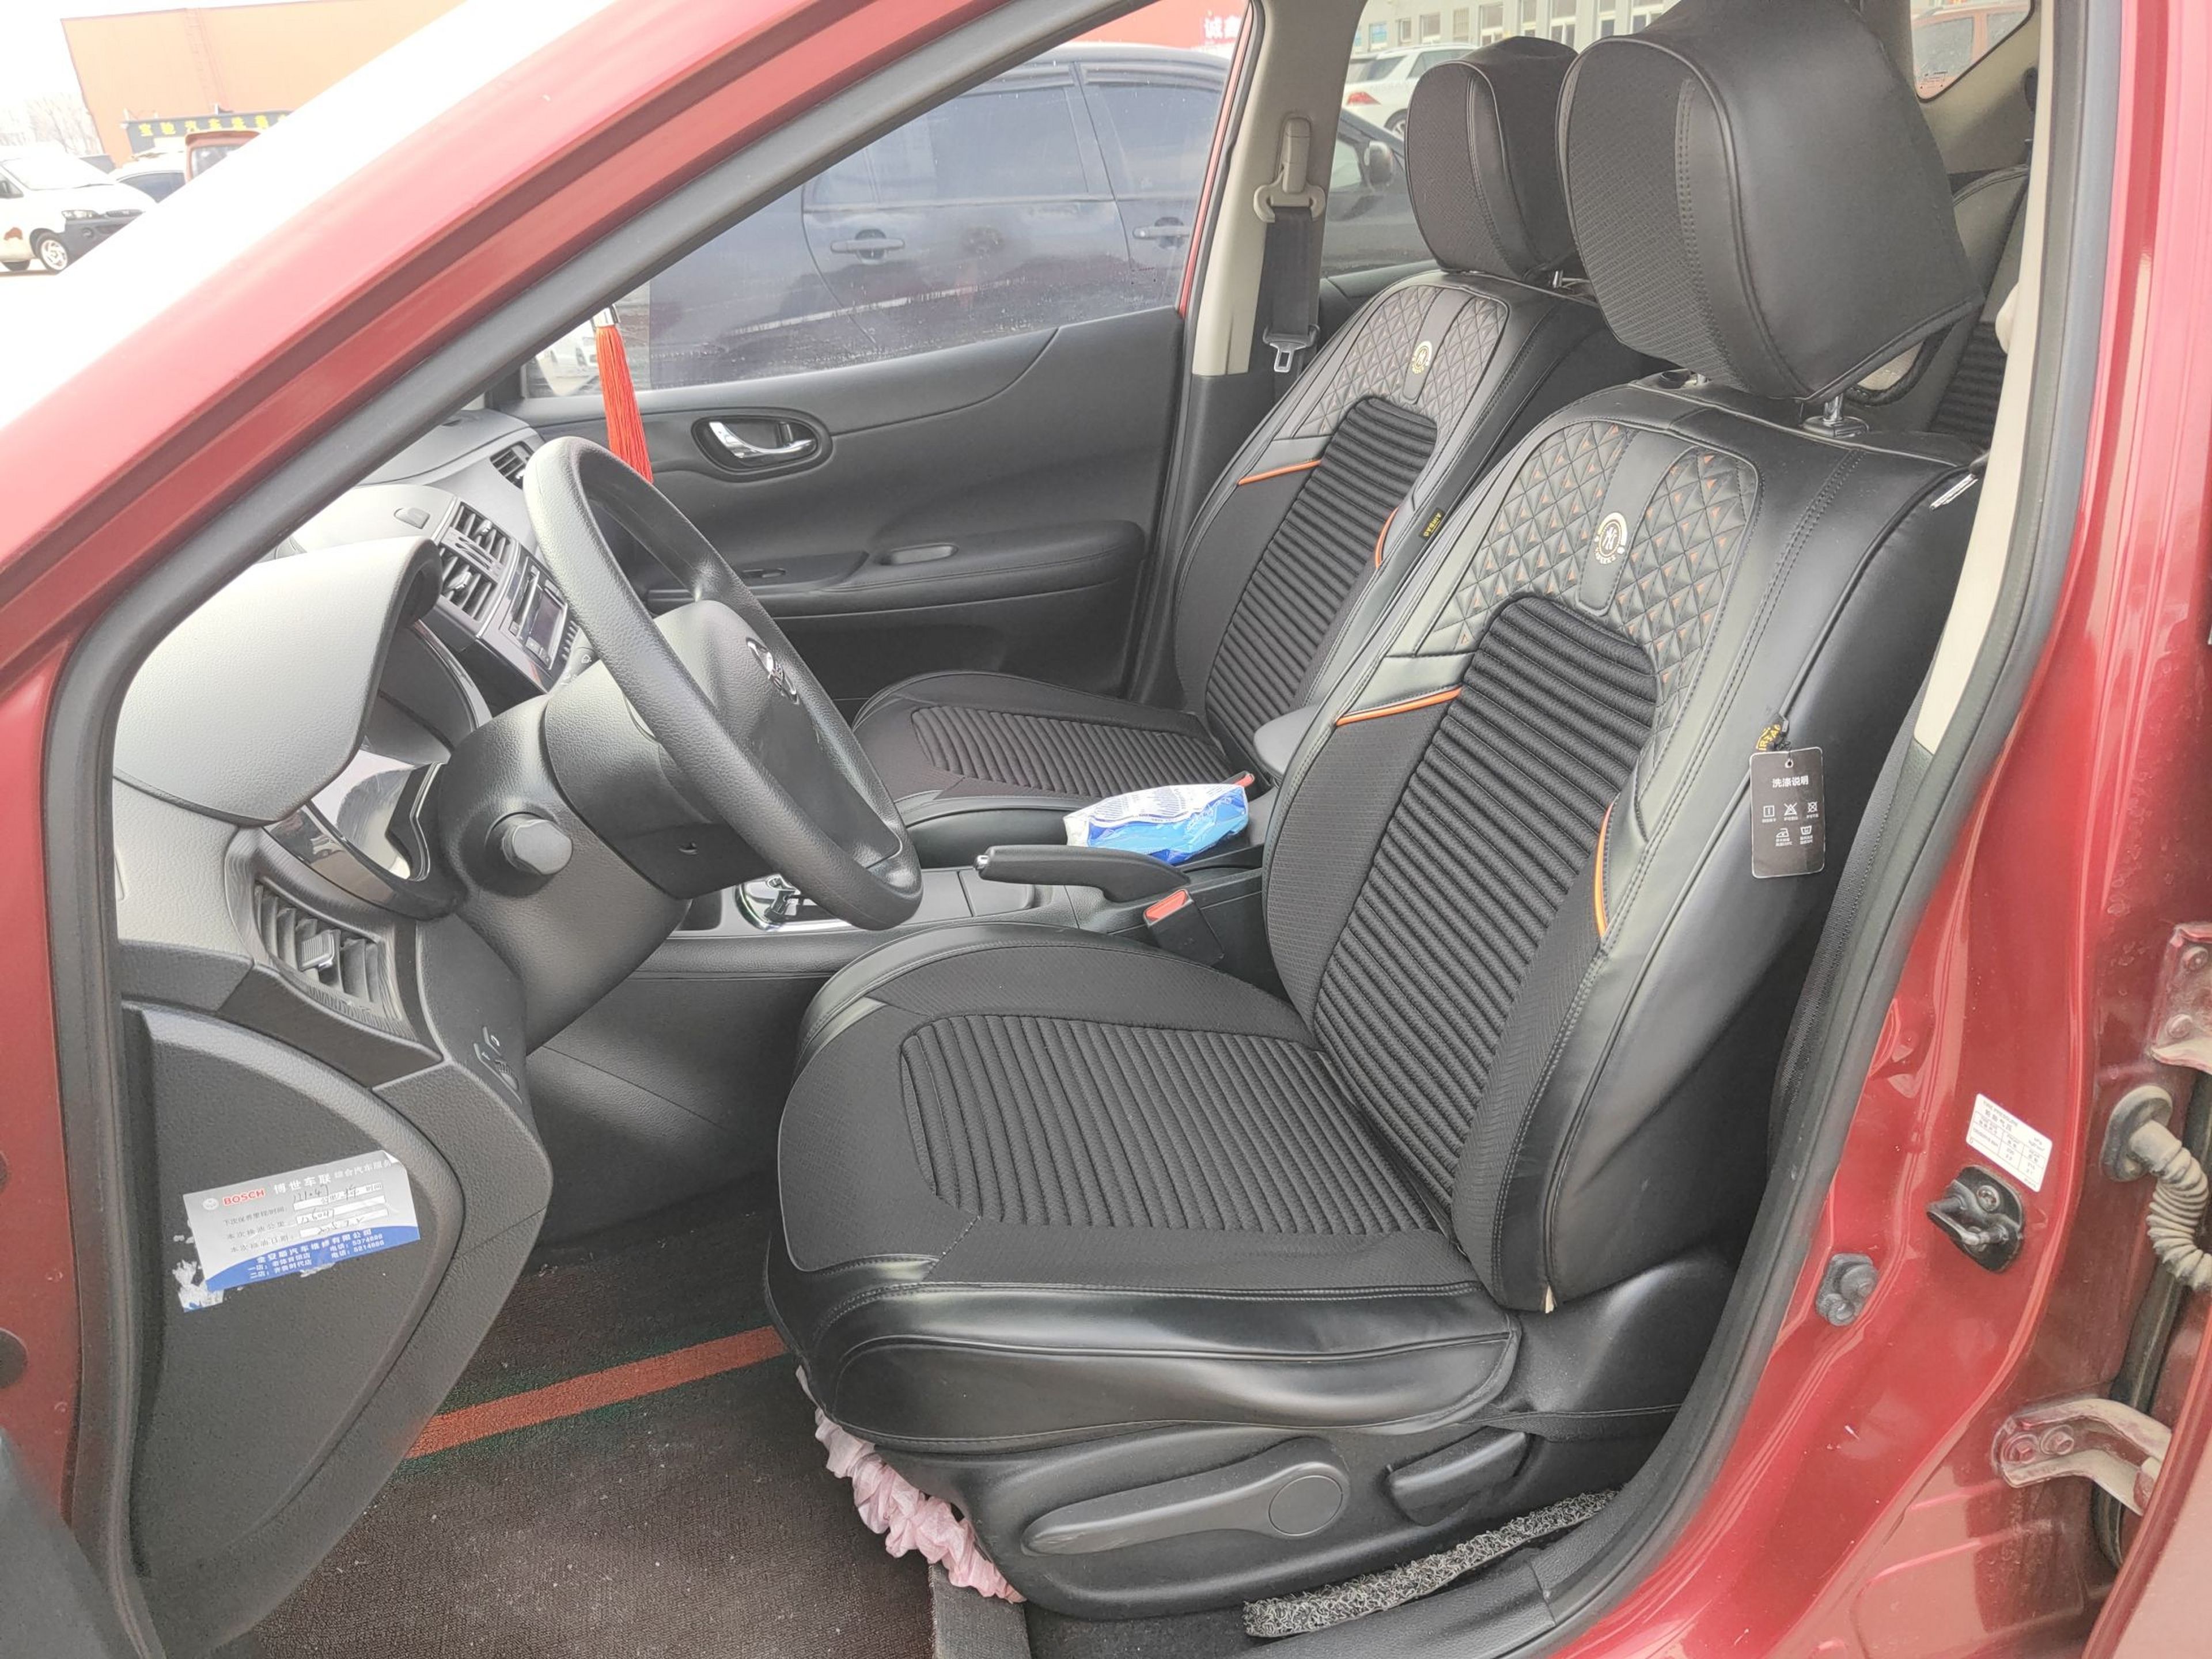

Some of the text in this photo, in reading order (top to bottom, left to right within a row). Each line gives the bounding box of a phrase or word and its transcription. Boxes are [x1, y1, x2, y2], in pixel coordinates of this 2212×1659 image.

[1772, 775, 1809, 788] 洗涤说明
[223, 1188, 266, 1206] BOSCH
[274, 1173, 331, 1195] 博世车联
